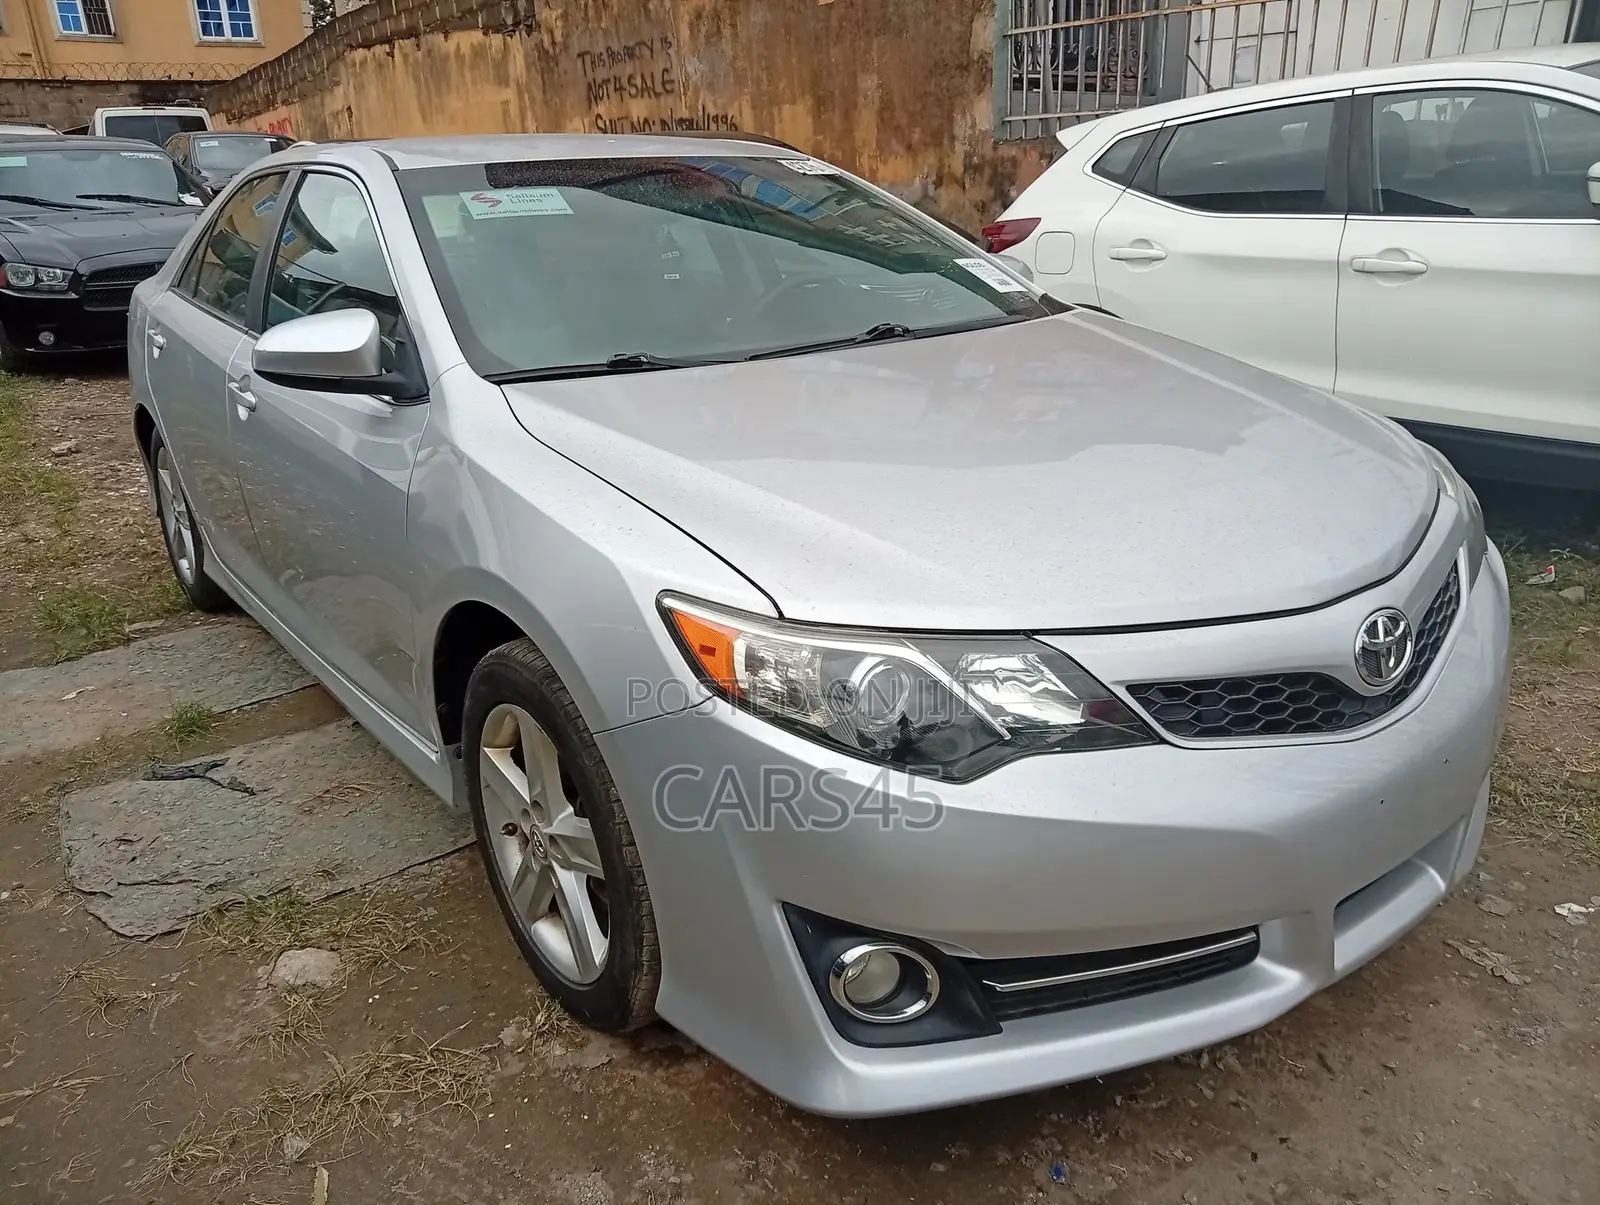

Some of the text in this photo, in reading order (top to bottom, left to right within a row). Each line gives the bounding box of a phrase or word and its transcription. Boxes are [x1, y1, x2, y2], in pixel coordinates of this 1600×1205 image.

[576, 50, 606, 77] THIS
[660, 36, 673, 50] IS
[587, 67, 676, 110] NOT 4 SALE
